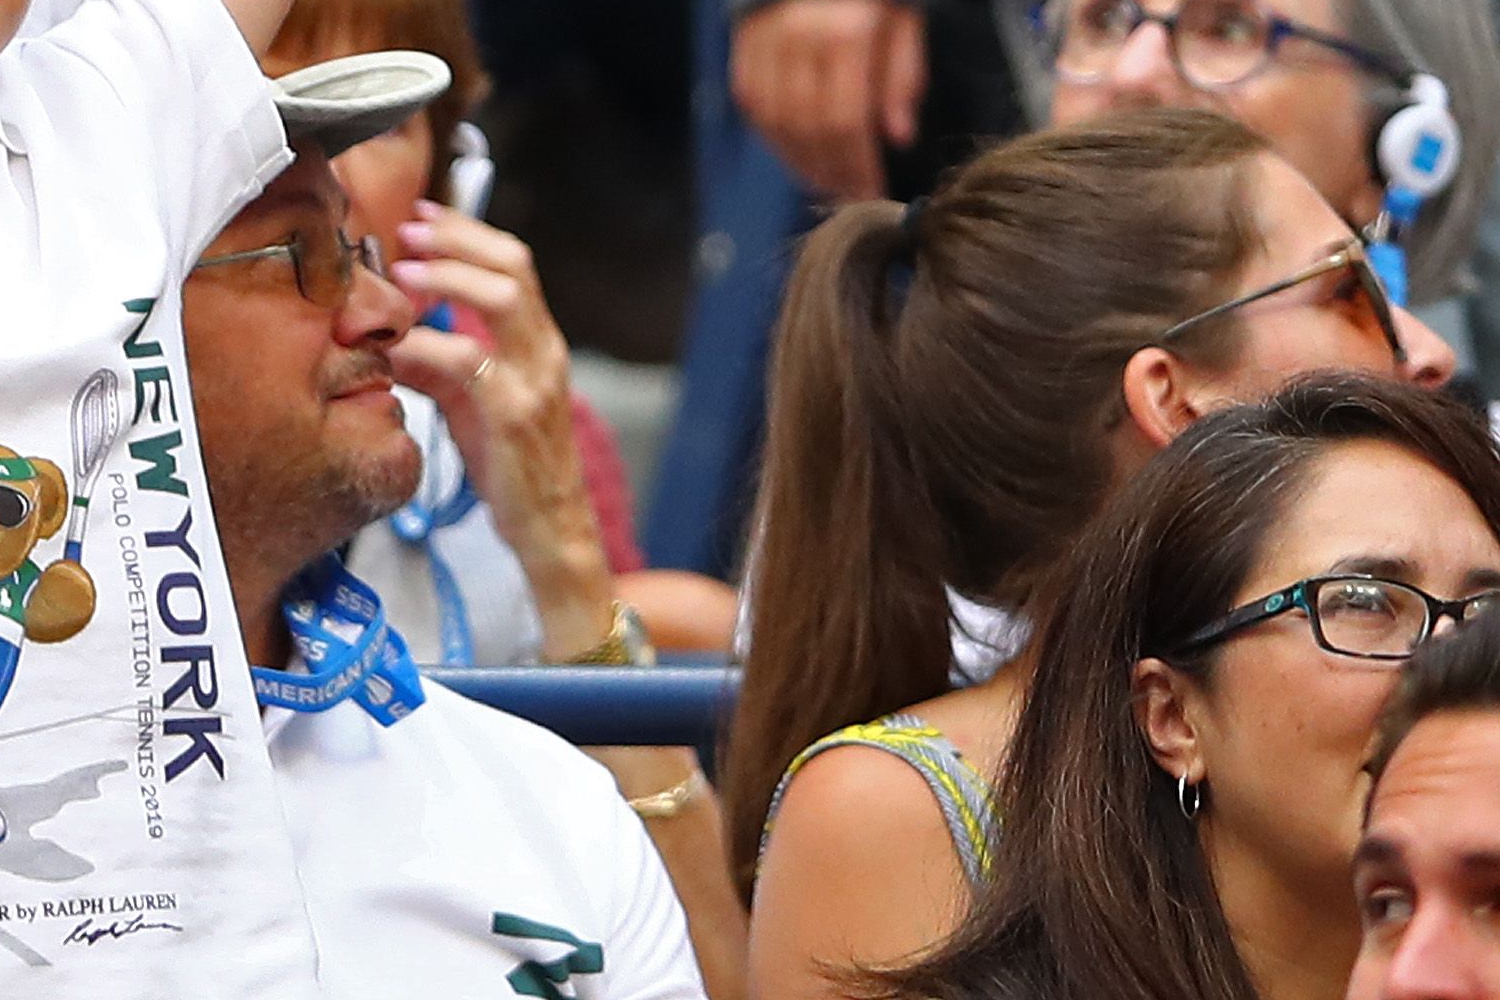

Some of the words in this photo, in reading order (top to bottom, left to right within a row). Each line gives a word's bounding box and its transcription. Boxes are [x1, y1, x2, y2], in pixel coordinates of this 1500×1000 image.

[122, 297, 190, 498] NEW
[108, 473, 131, 528] POLO
[119, 535, 152, 688] COMPETITION
[144, 504, 226, 784] YORK
[256, 656, 362, 704] MERICAN
[137, 695, 155, 779] TENNIS
[141, 785, 164, 840] 2019
[16, 904, 37, 923] by
[43, 898, 104, 918] RALPH
[109, 893, 177, 913] LAUREN
